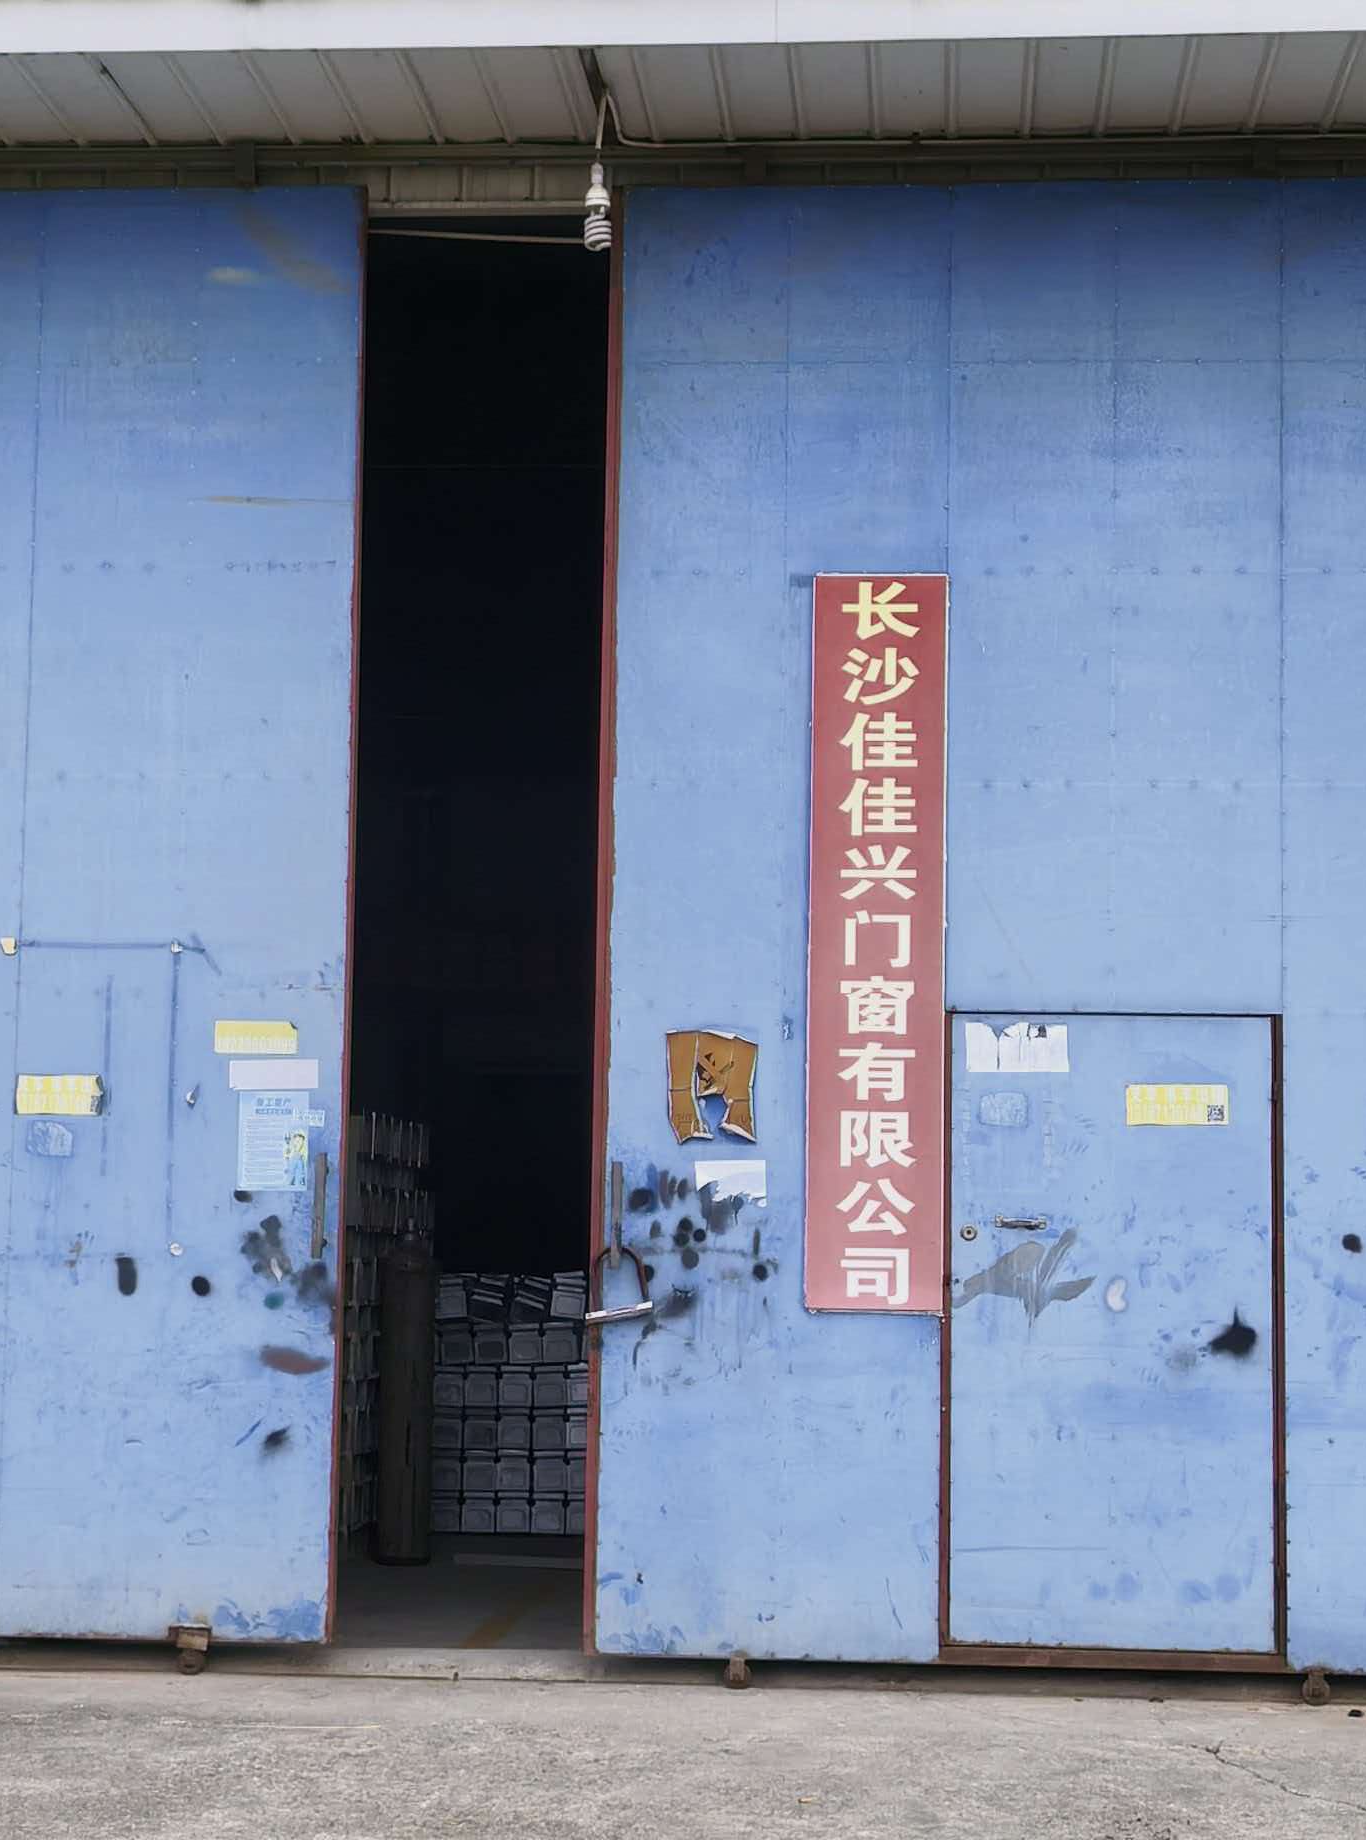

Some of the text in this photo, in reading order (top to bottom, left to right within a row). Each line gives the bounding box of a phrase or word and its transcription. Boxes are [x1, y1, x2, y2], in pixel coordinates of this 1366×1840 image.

[836, 581, 921, 1306] 长沙佳佳兴门窗有限公司
